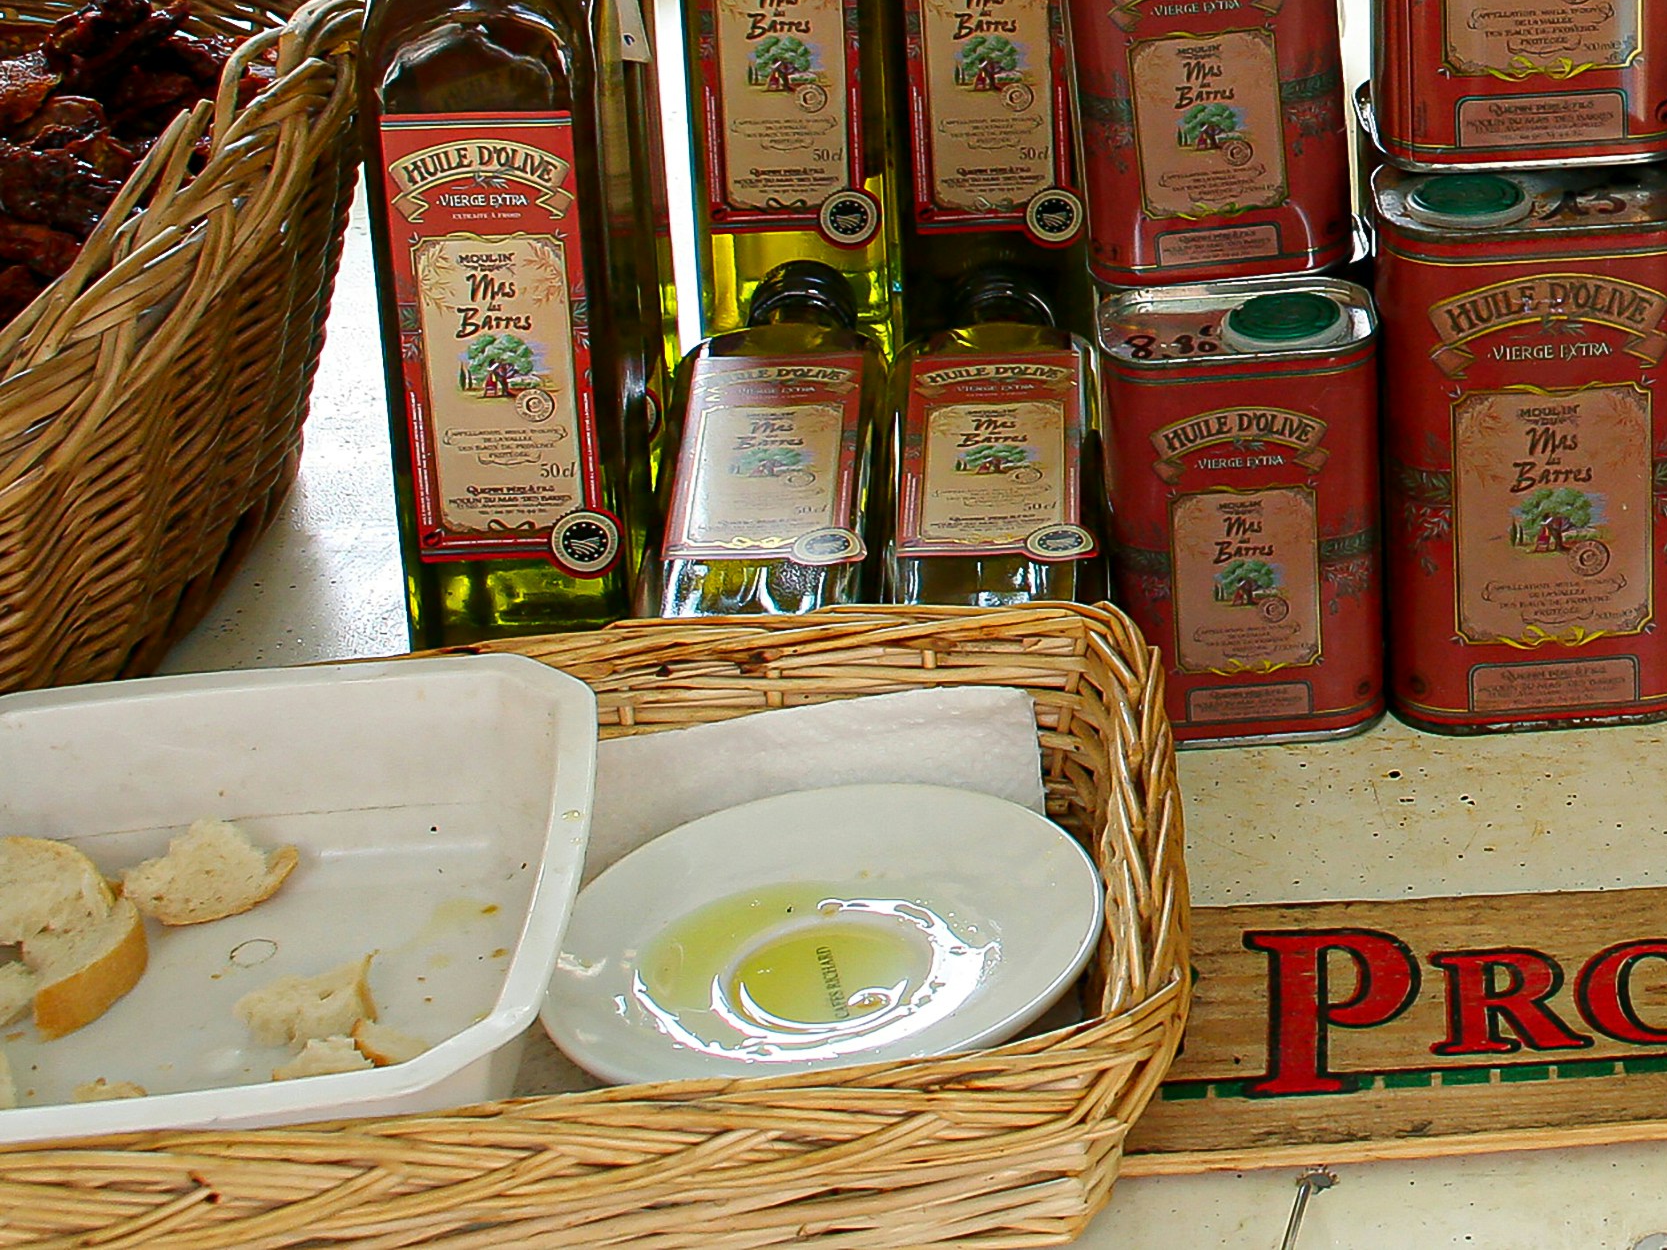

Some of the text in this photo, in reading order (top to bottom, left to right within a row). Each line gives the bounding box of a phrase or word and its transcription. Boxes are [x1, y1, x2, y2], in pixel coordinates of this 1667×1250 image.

[746, 13, 811, 40] Barres
[953, 12, 1017, 40] Barres
[1182, 61, 1222, 82] Mas
[1173, 85, 1235, 109] Barres
[813, 148, 843, 162] 50 cl
[1019, 146, 1050, 160] 50 cl
[402, 145, 558, 187] HUILE D'OLIVE
[439, 193, 528, 208] VIERGE EXTRA
[458, 253, 515, 264] MOULIN
[466, 273, 516, 303] Mas
[1446, 281, 1655, 336] HUILE D'OLIVE
[455, 307, 532, 339] Barres
[1492, 344, 1554, 361] VIERGE
[927, 367, 990, 384] HUILE
[957, 433, 1028, 448] Barres
[1162, 412, 1317, 454] HUILE D'OLIVE
[1525, 427, 1579, 457] Mas
[540, 461, 577, 478] 50 cl
[1509, 461, 1593, 494] Barres
[1223, 516, 1263, 537] Mas
[1213, 541, 1274, 565] Barres
